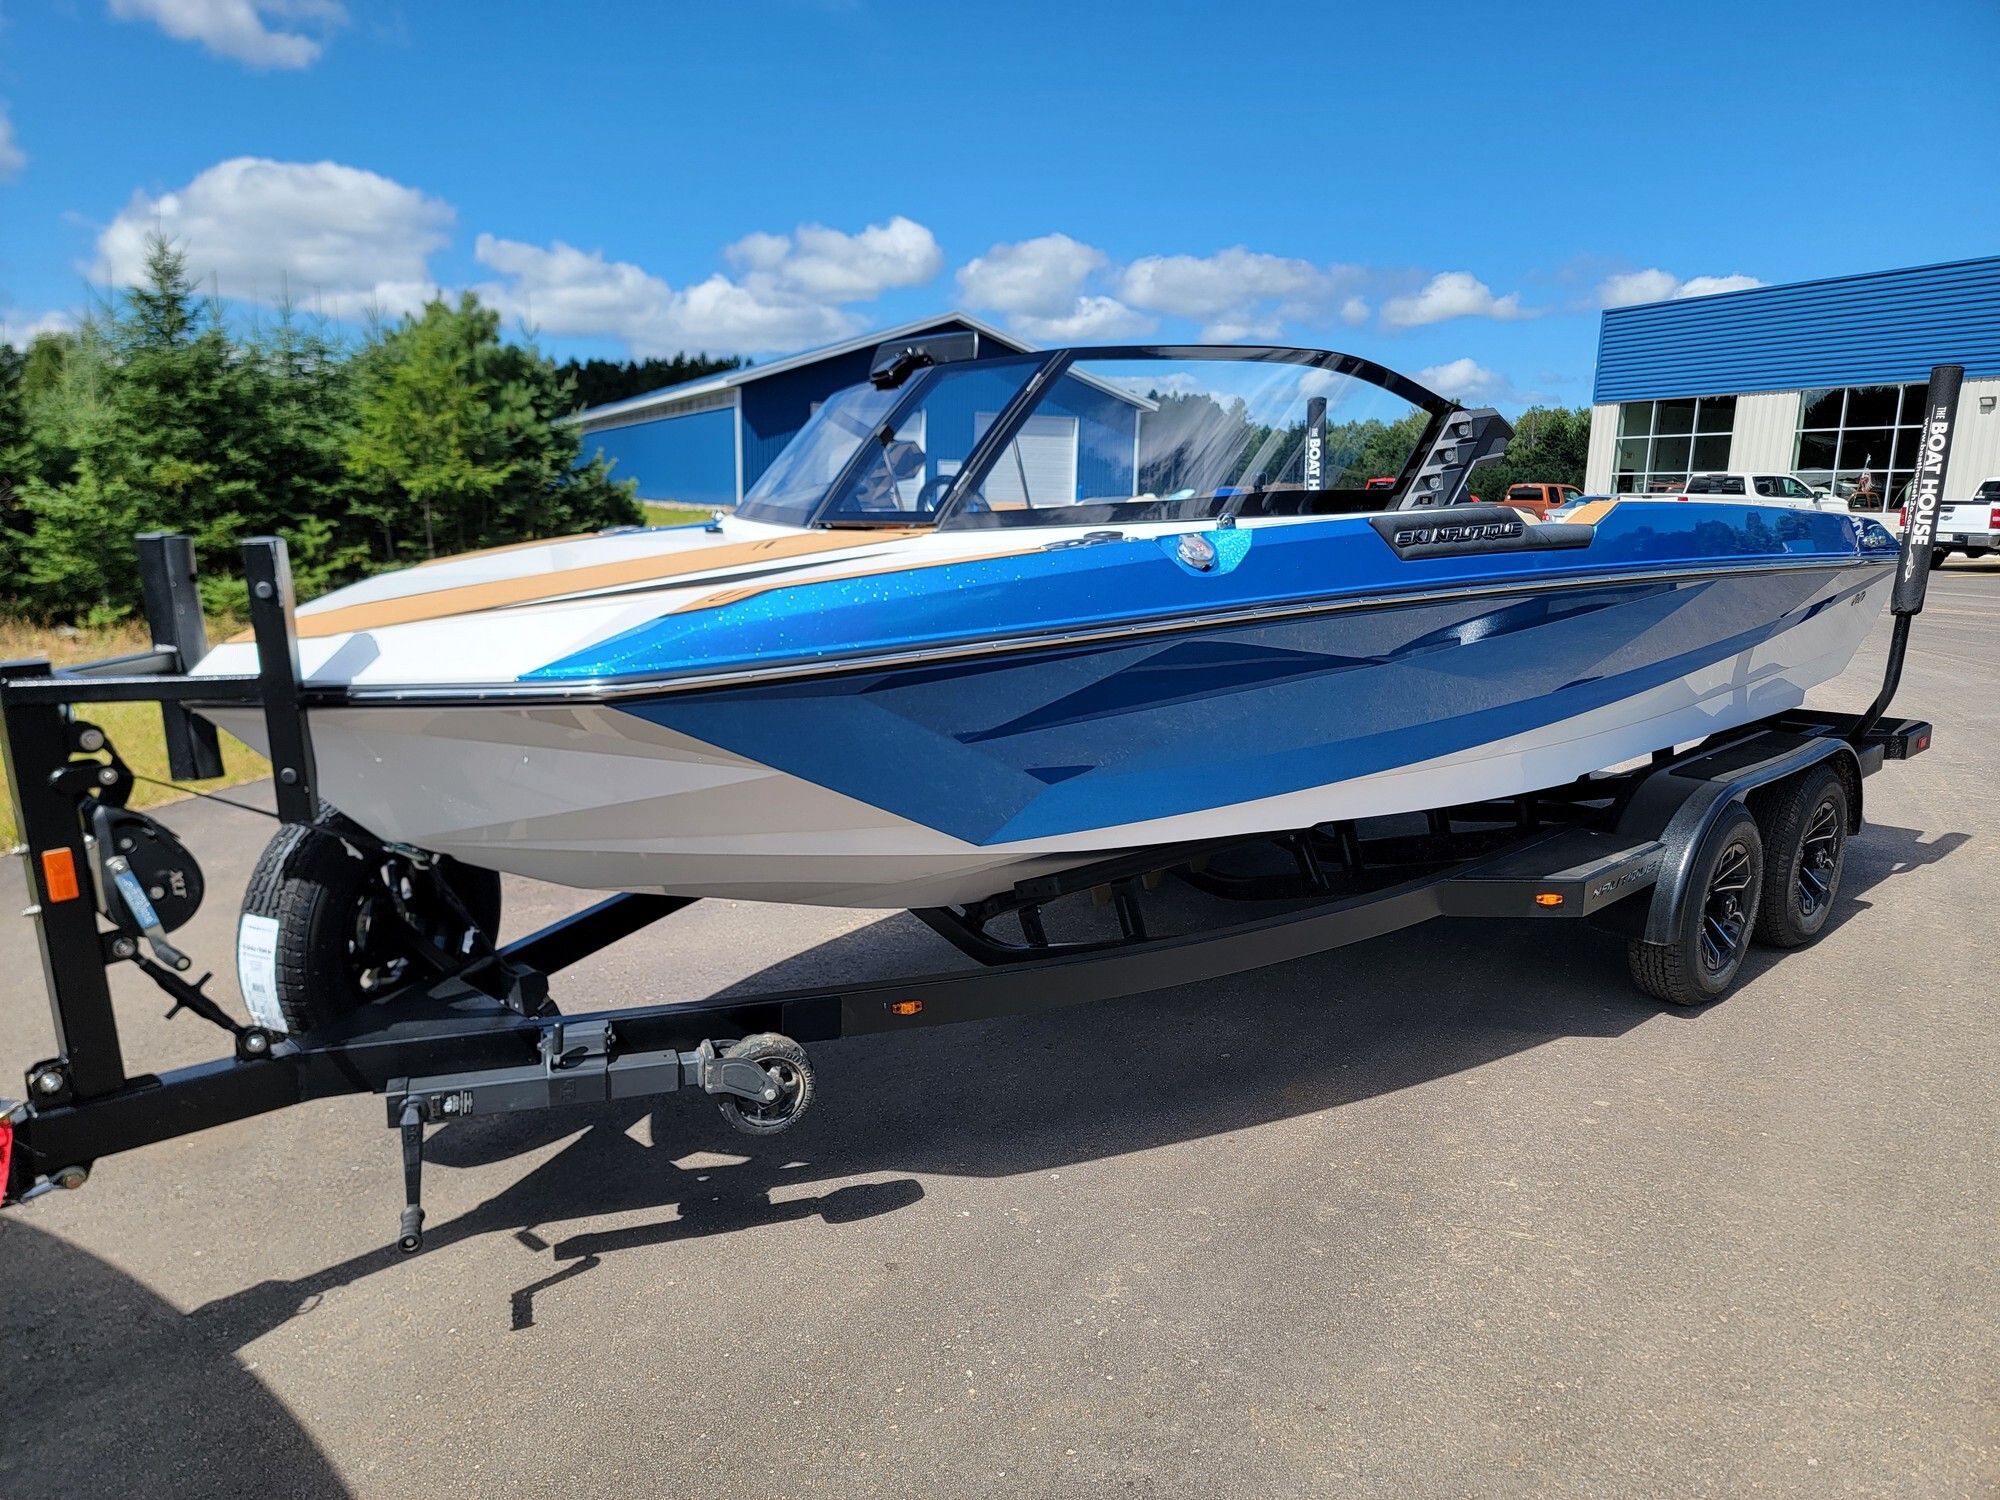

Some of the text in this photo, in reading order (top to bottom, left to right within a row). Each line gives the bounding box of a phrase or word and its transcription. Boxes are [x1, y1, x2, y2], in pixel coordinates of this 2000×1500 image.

[1309, 438, 1321, 477] BOAT
[1904, 417, 1930, 534] www.boathouseh2o.com
[1912, 406, 1949, 546] THE BOAT HOUSE
[1395, 522, 1524, 546] SKI NAUTIQUE
[168, 869, 188, 899] XLT
[1592, 861, 1657, 900] NAUTIQUE
